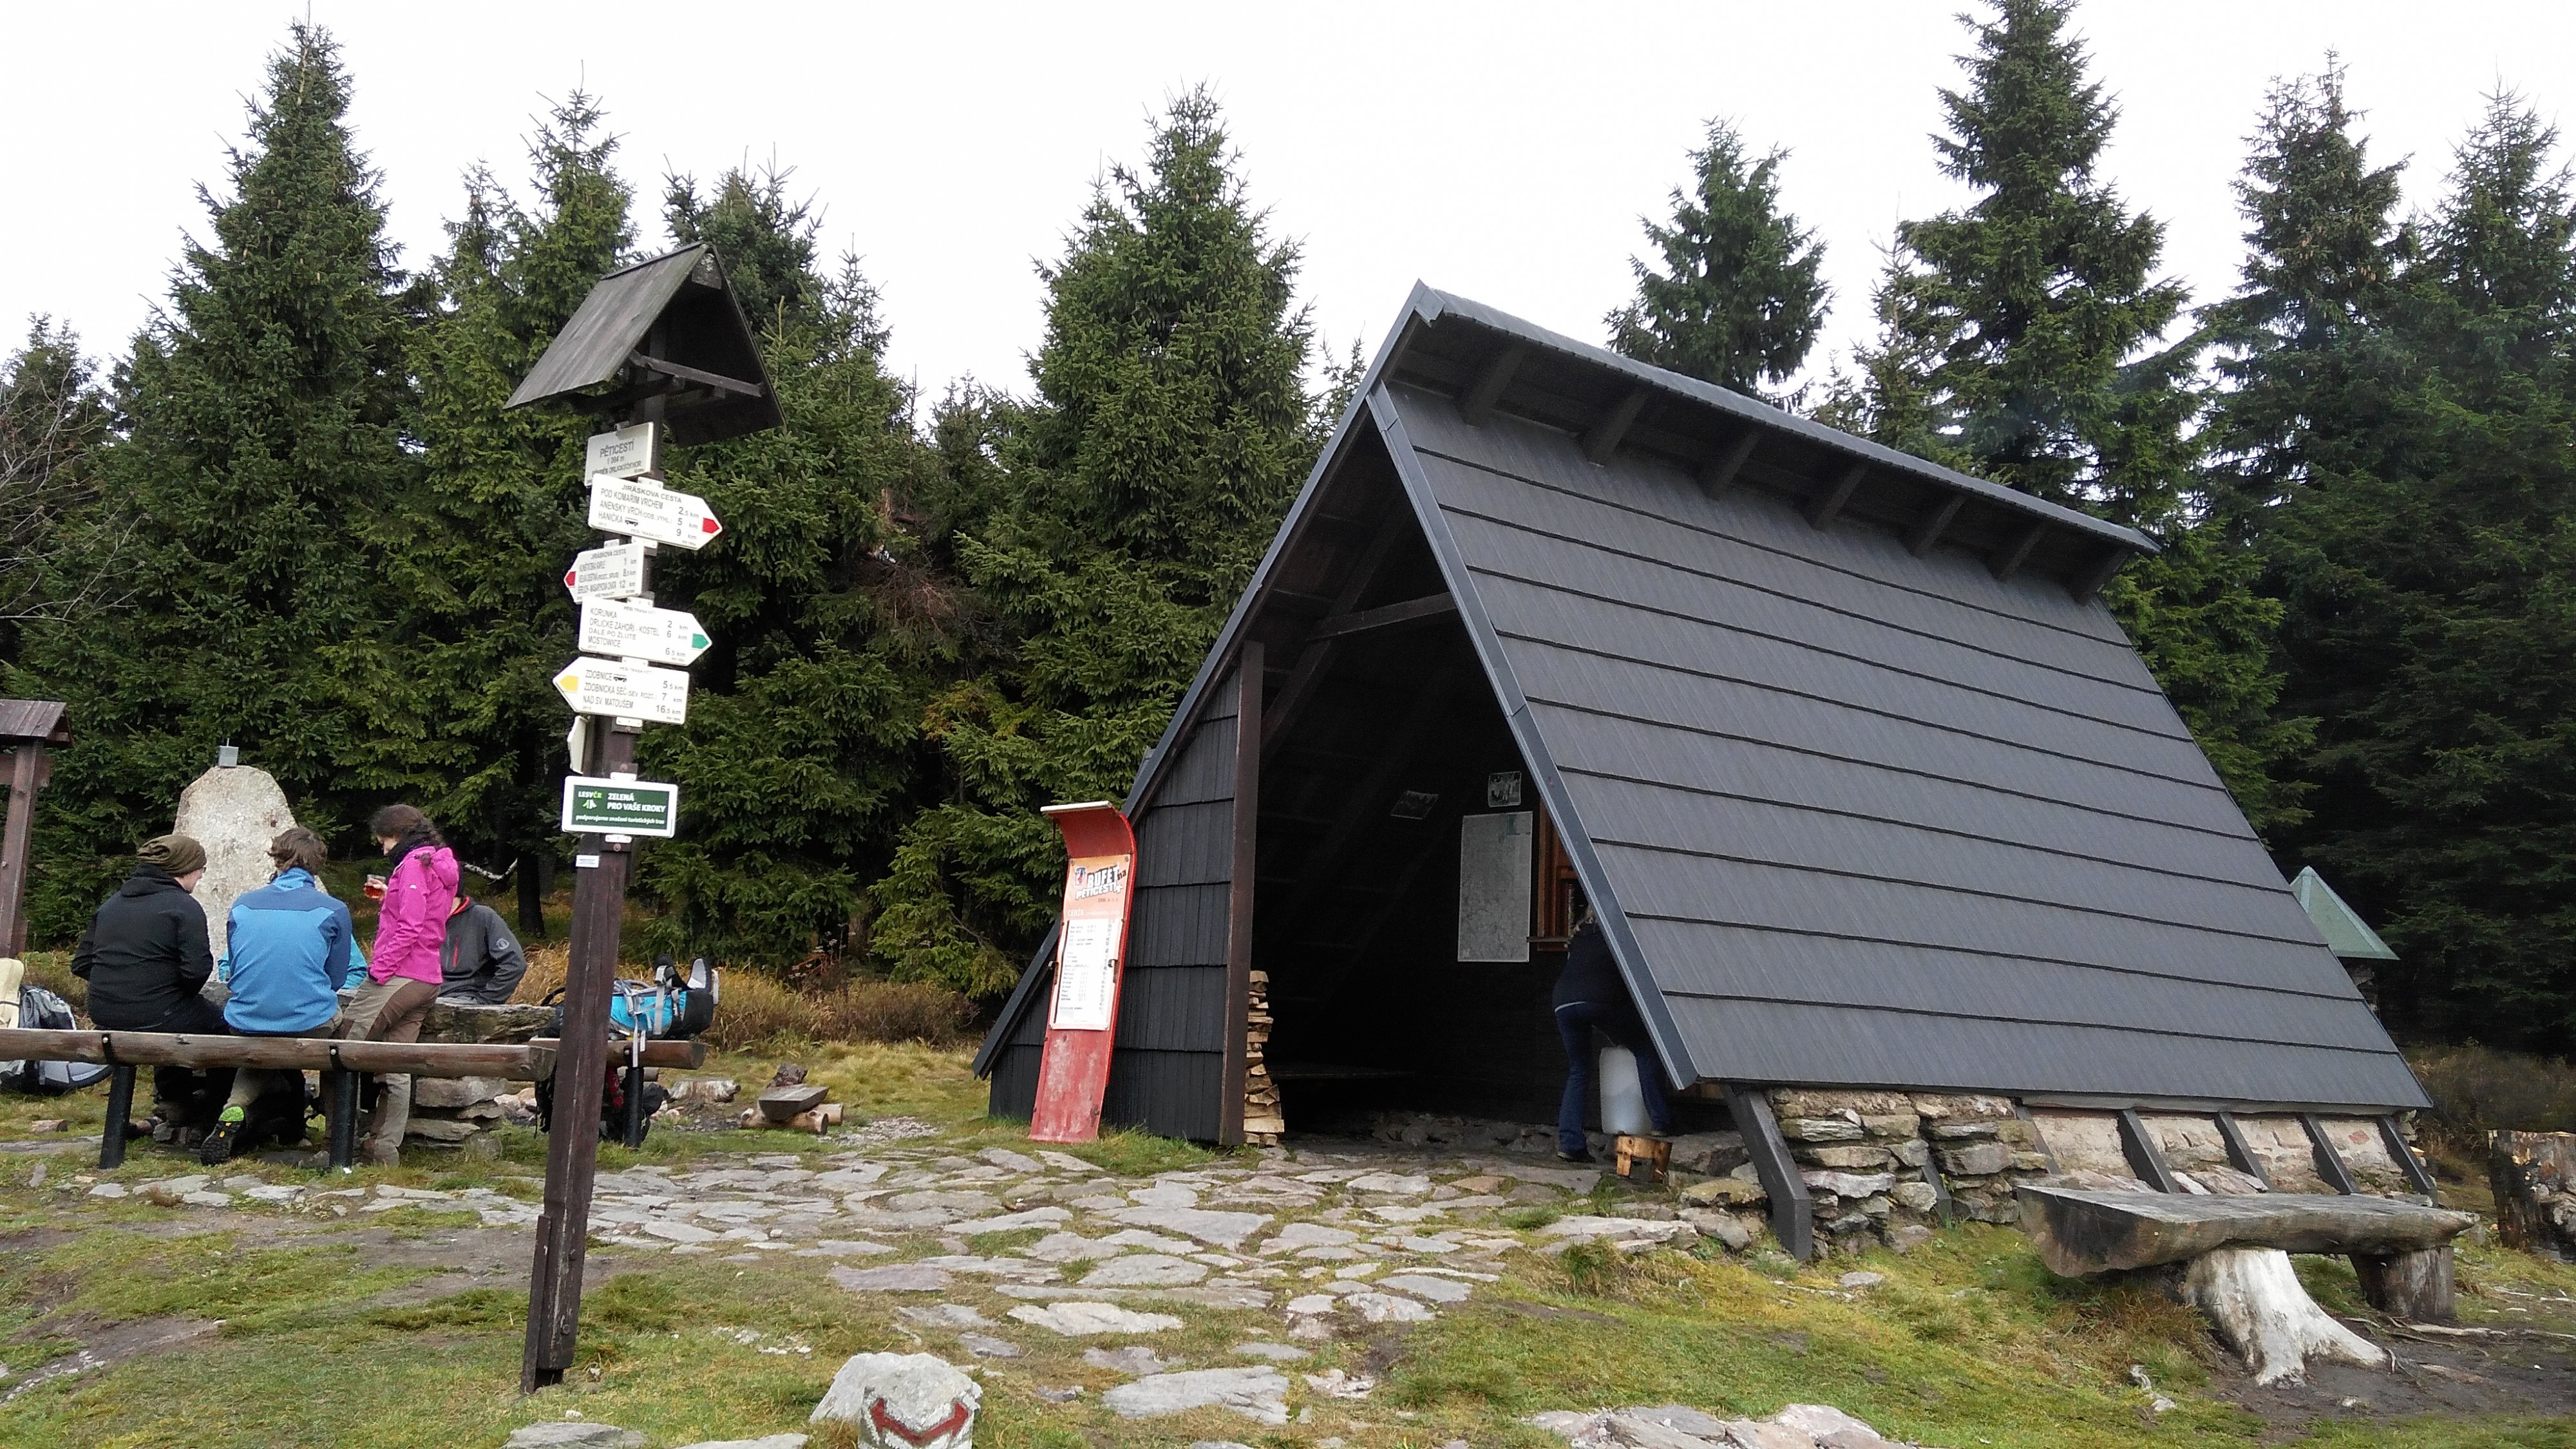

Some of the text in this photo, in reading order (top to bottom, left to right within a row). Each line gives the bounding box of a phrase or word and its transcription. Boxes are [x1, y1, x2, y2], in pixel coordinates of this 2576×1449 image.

[600, 488, 612, 498] POD
[641, 497, 663, 509] VRCHEM
[661, 493, 682, 503] CESTA
[676, 528, 681, 536] 9
[619, 580, 626, 589] 12
[590, 608, 617, 618] KORUNKA
[639, 626, 659, 636] KOSTEL
[588, 636, 621, 648] MOSTOWICE
[585, 669, 612, 681] ZDOBNICE
[583, 695, 595, 704] NAD
[662, 692, 667, 701] 7
[607, 793, 634, 801] ZELENÁ
[607, 802, 667, 813] PRO VAŠE KROKY
[1087, 864, 1126, 888] BUFET na
